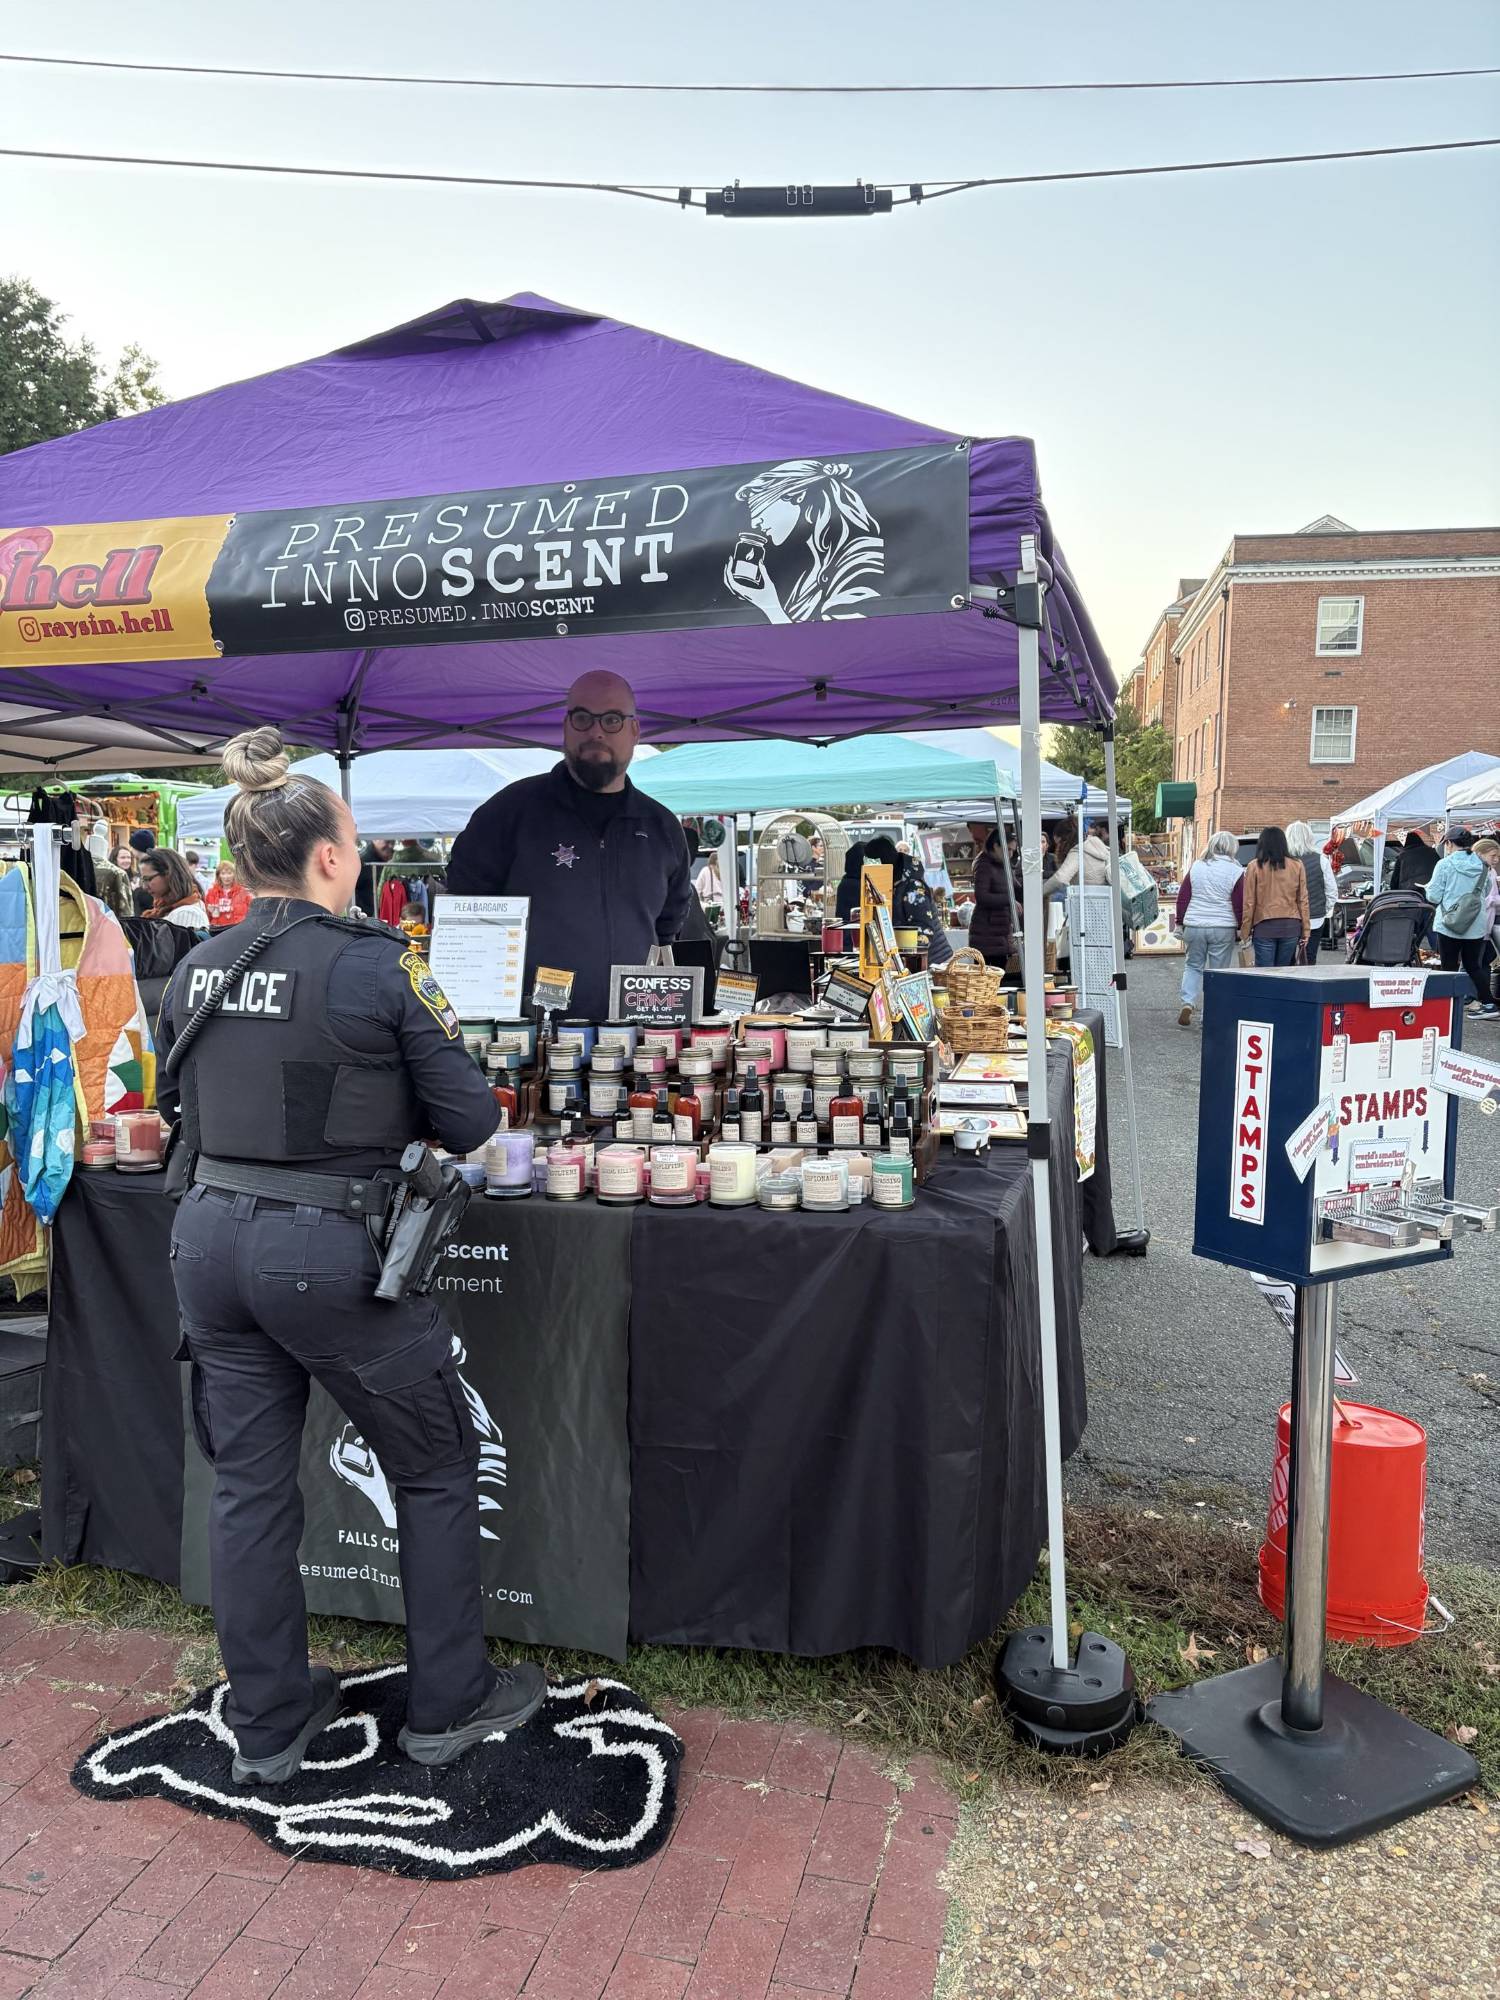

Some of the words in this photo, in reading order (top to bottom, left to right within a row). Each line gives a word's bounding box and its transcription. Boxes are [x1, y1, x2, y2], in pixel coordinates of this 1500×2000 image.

[279, 483, 690, 559] PRESUMED
[2, 545, 163, 611] hell
[262, 532, 674, 608] INNOSCENT
[368, 597, 595, 627] PRESUMED.INNOSCENT
[454, 902, 472, 912] PLEA
[473, 903, 508, 913] BARGAINS
[187, 968, 288, 1014] POLICE
[624, 977, 691, 990] CONFESS
[1373, 979, 1397, 987] venmo
[1411, 977, 1423, 986] for
[1380, 986, 1414, 997] quarters!
[624, 992, 684, 1007] CRIME
[1334, 1012, 1341, 1025] S
[1451, 1073, 1486, 1089] stickers
[1340, 1086, 1428, 1126] STAMPS
[1237, 1034, 1263, 1209] STAMPS
[444, 1244, 509, 1261] scent
[338, 1529, 378, 1548] FALLS
[481, 1584, 534, 1605] .com
